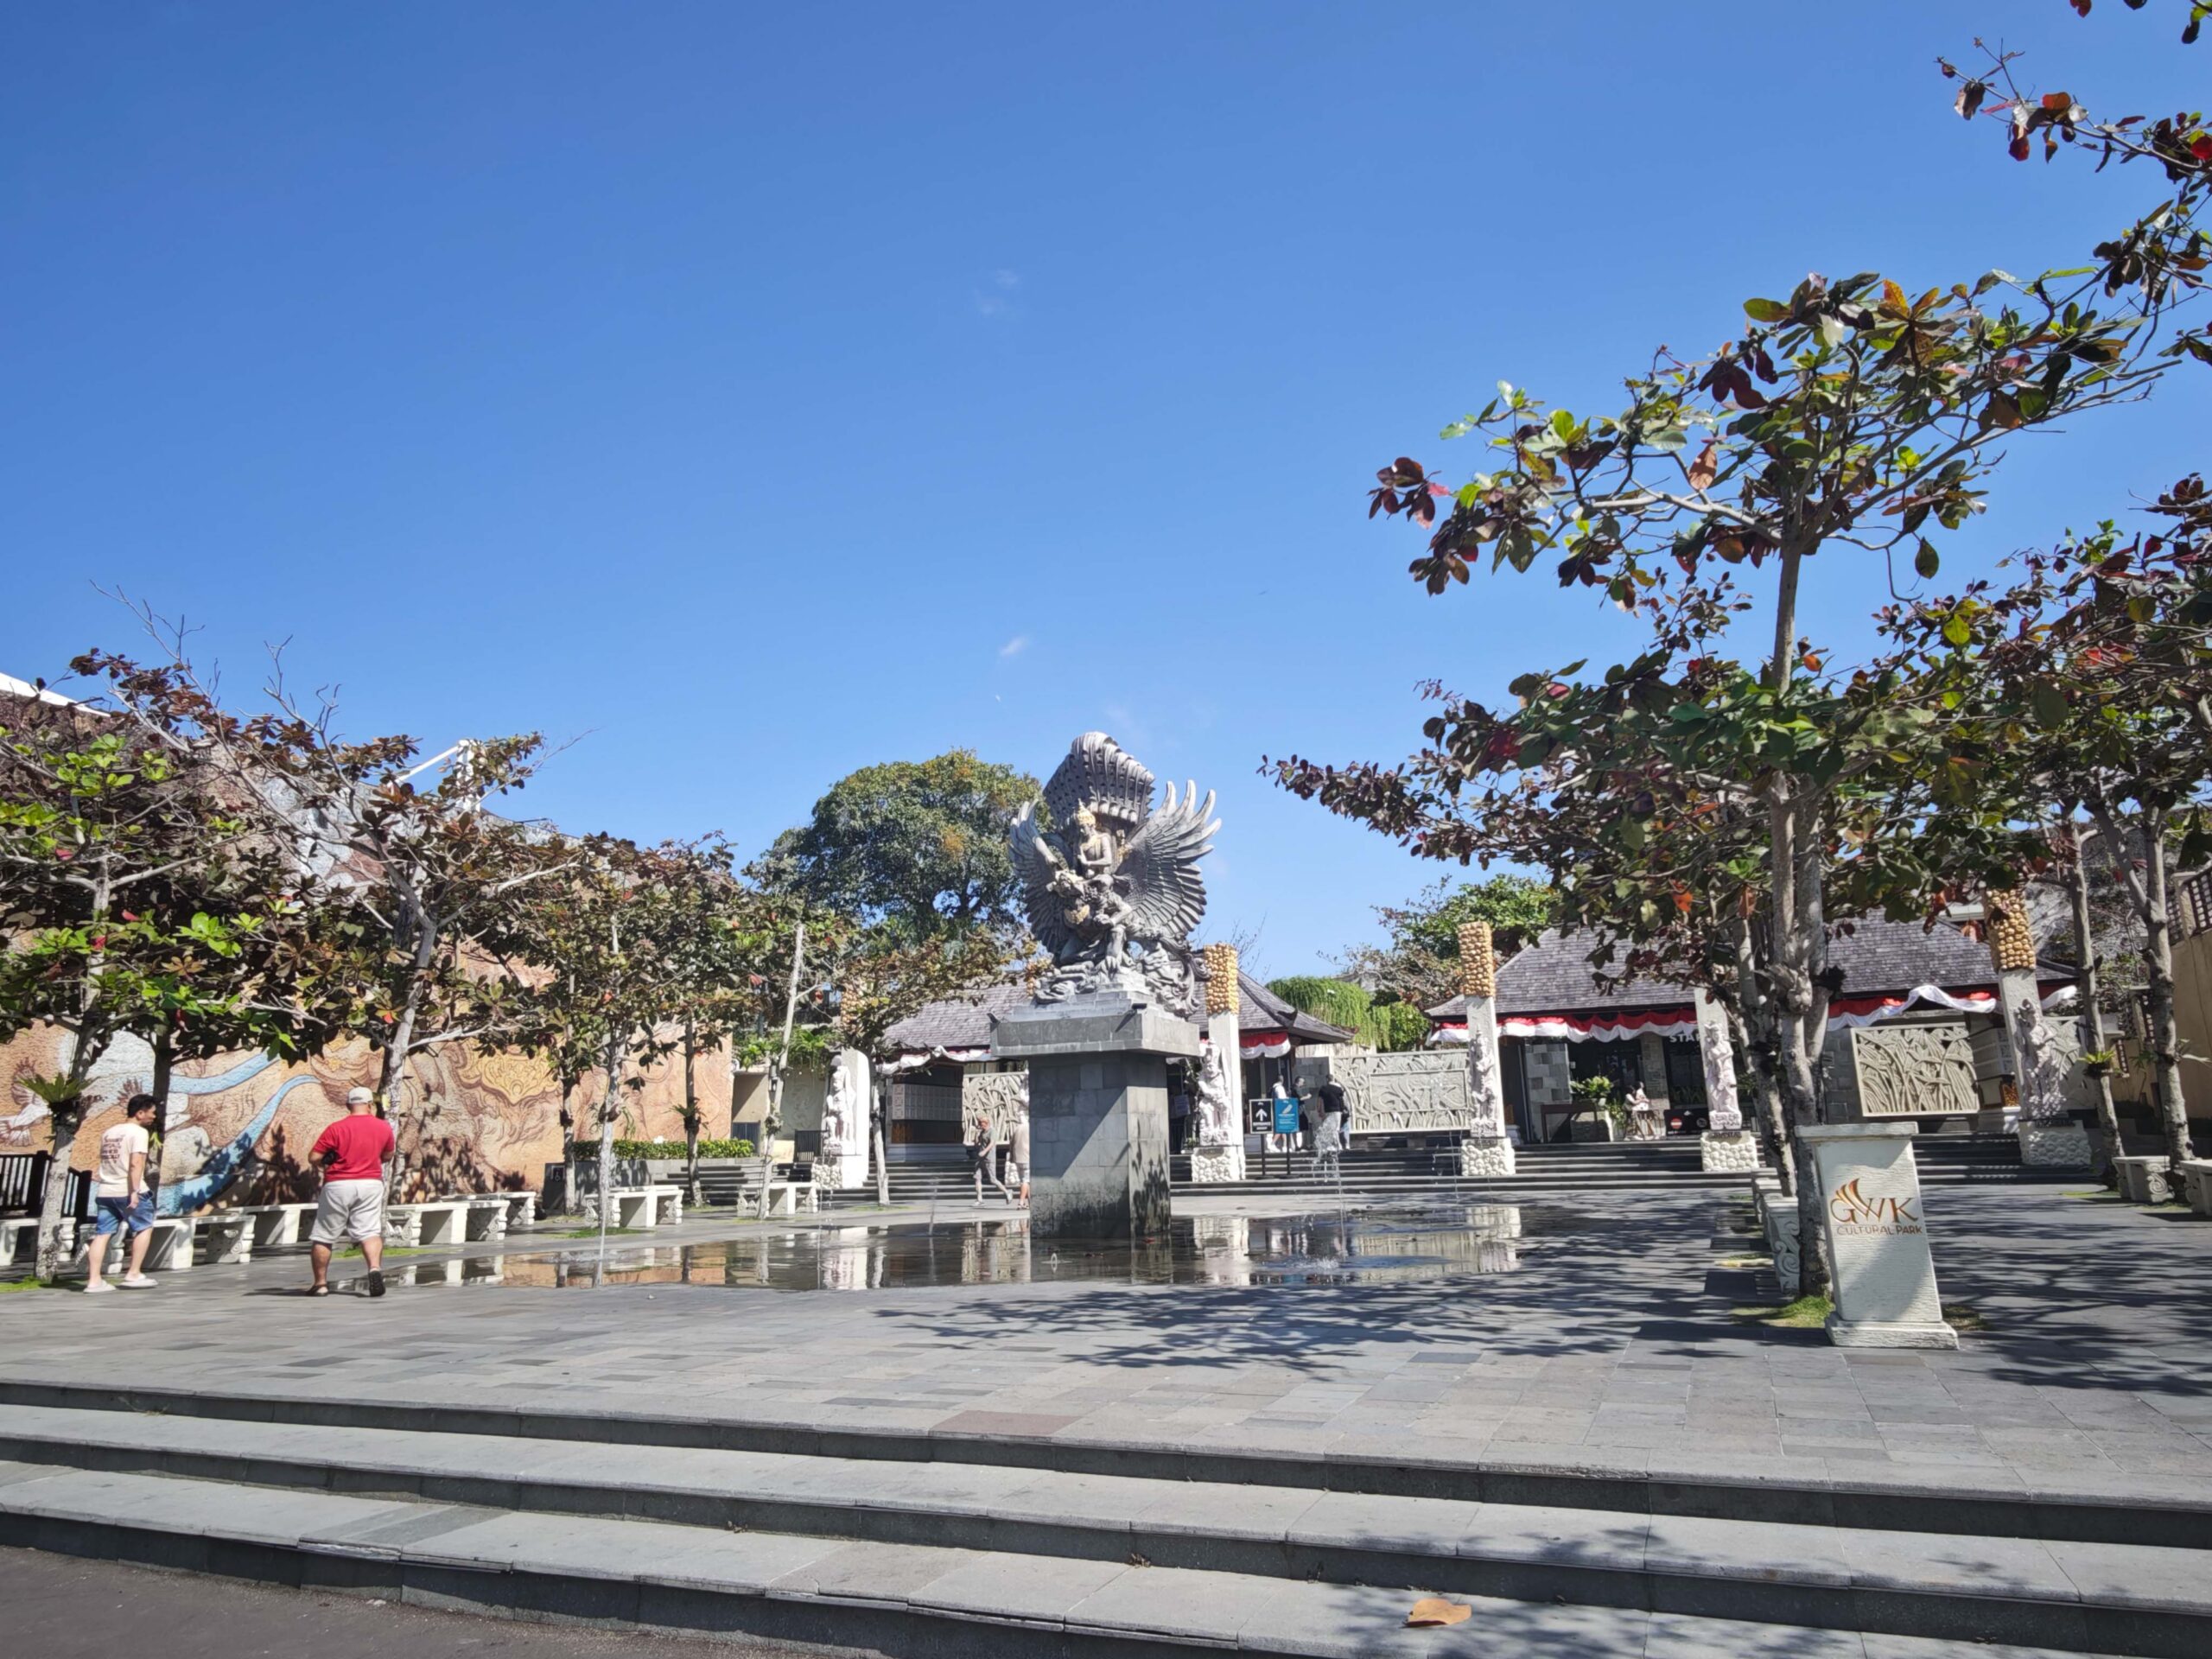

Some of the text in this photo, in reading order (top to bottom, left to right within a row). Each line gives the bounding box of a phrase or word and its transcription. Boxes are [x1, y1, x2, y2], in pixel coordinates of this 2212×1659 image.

[1830, 1179, 1919, 1224] GWK
[1837, 1224, 1923, 1236] CULTURAL PARK
